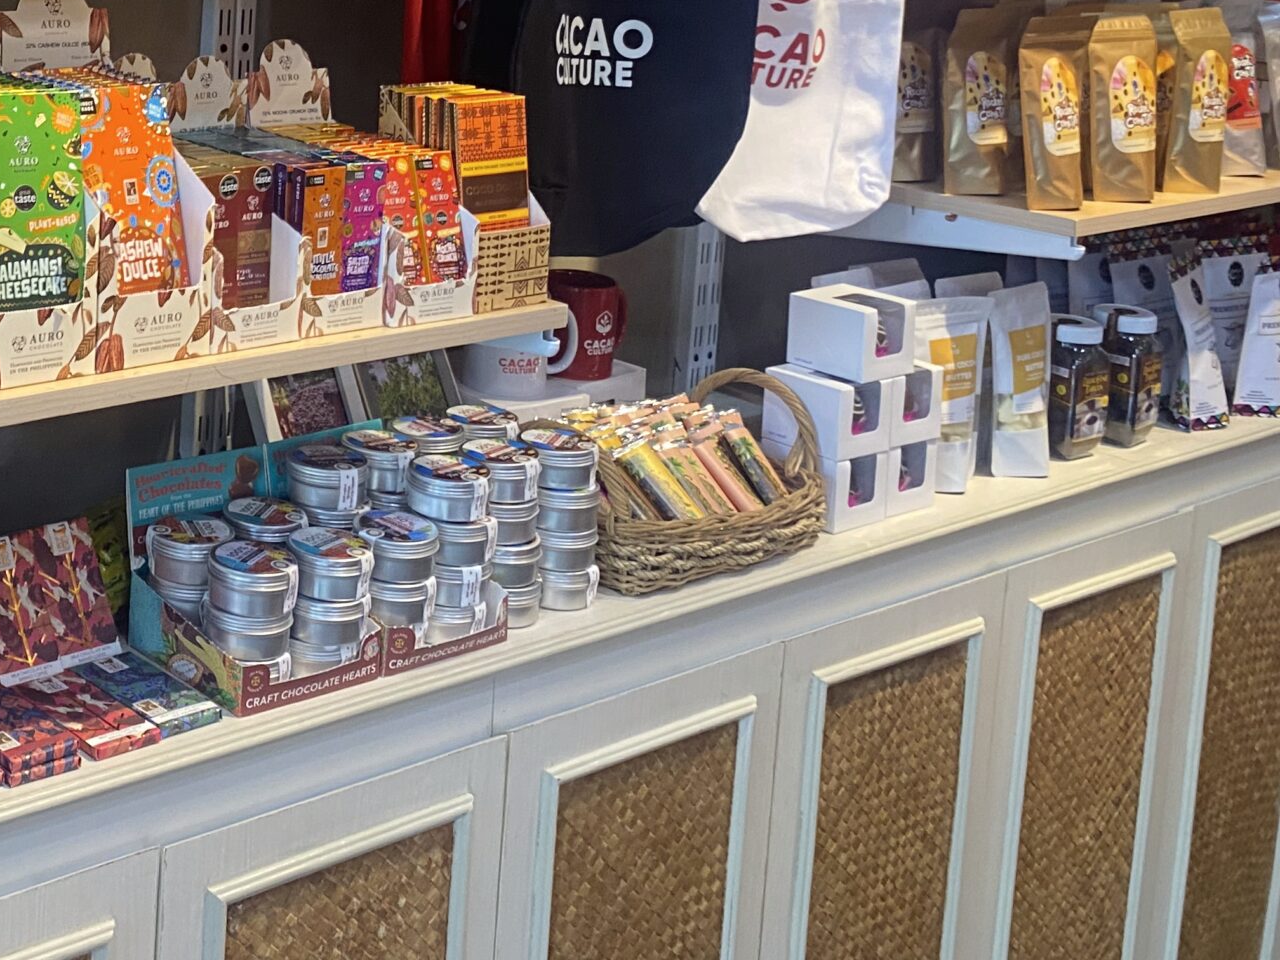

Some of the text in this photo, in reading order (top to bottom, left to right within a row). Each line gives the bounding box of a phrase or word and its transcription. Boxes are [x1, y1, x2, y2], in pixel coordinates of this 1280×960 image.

[41, 19, 71, 29] AURO
[556, 13, 653, 59] CACAO
[753, 24, 825, 65] CAO
[275, 73, 300, 82] AURO
[751, 64, 817, 89] TURE
[194, 91, 218, 99] AURO
[113, 147, 138, 156] AURO
[8, 156, 39, 167] AURO
[14, 194, 37, 204] taste
[429, 193, 449, 202] AURO
[353, 205, 374, 213] AURO
[314, 210, 335, 219] AURO
[122, 258, 161, 282] DULCE
[150, 312, 183, 326] AURO
[254, 310, 279, 321] AURO
[29, 330, 64, 344] AURO
[498, 358, 539, 368] CACAO
[503, 367, 537, 375] CULTURE
[388, 627, 507, 669] CRAFT CHOCOLATE HEARTS
[245, 663, 377, 709] CRAFT CHOCOLATE HEARTS
